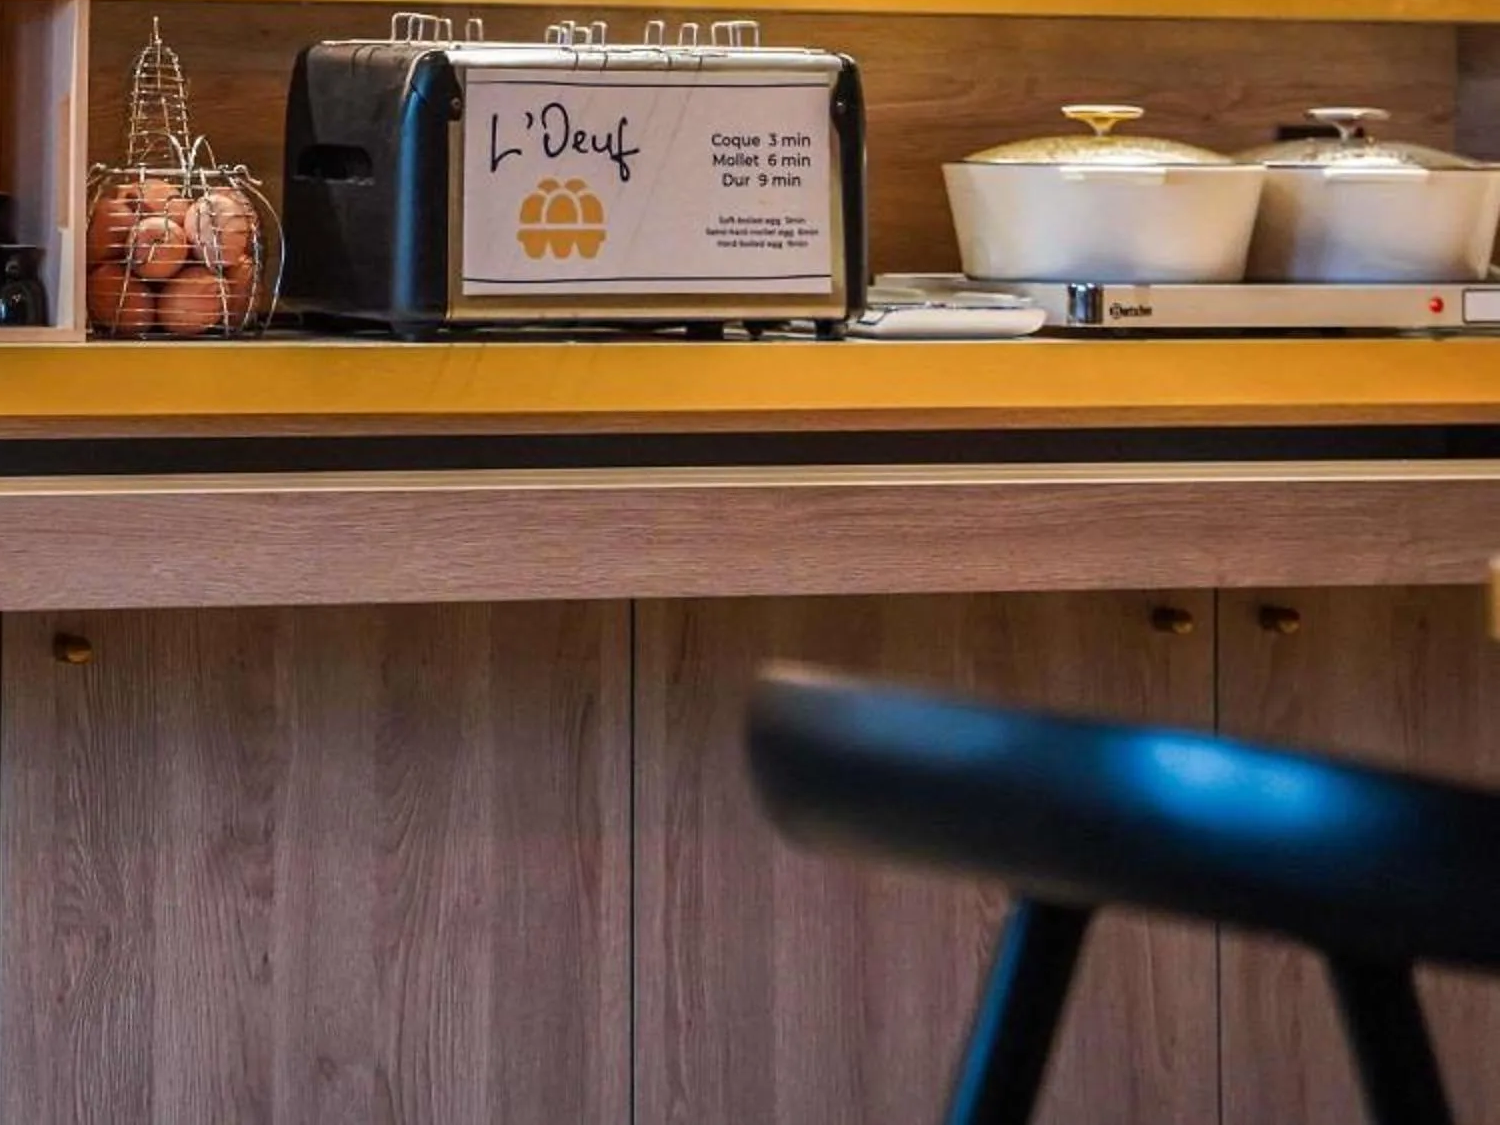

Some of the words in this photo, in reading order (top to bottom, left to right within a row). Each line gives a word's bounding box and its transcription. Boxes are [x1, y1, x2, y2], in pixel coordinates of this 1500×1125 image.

[711, 133, 761, 150] Coque
[768, 133, 777, 147] 3
[781, 133, 811, 148] min
[712, 154, 760, 167] Mollet
[767, 154, 777, 167] 6
[781, 154, 811, 167] min
[722, 173, 750, 187] Dur
[758, 174, 768, 187] 9
[771, 173, 801, 187] min
